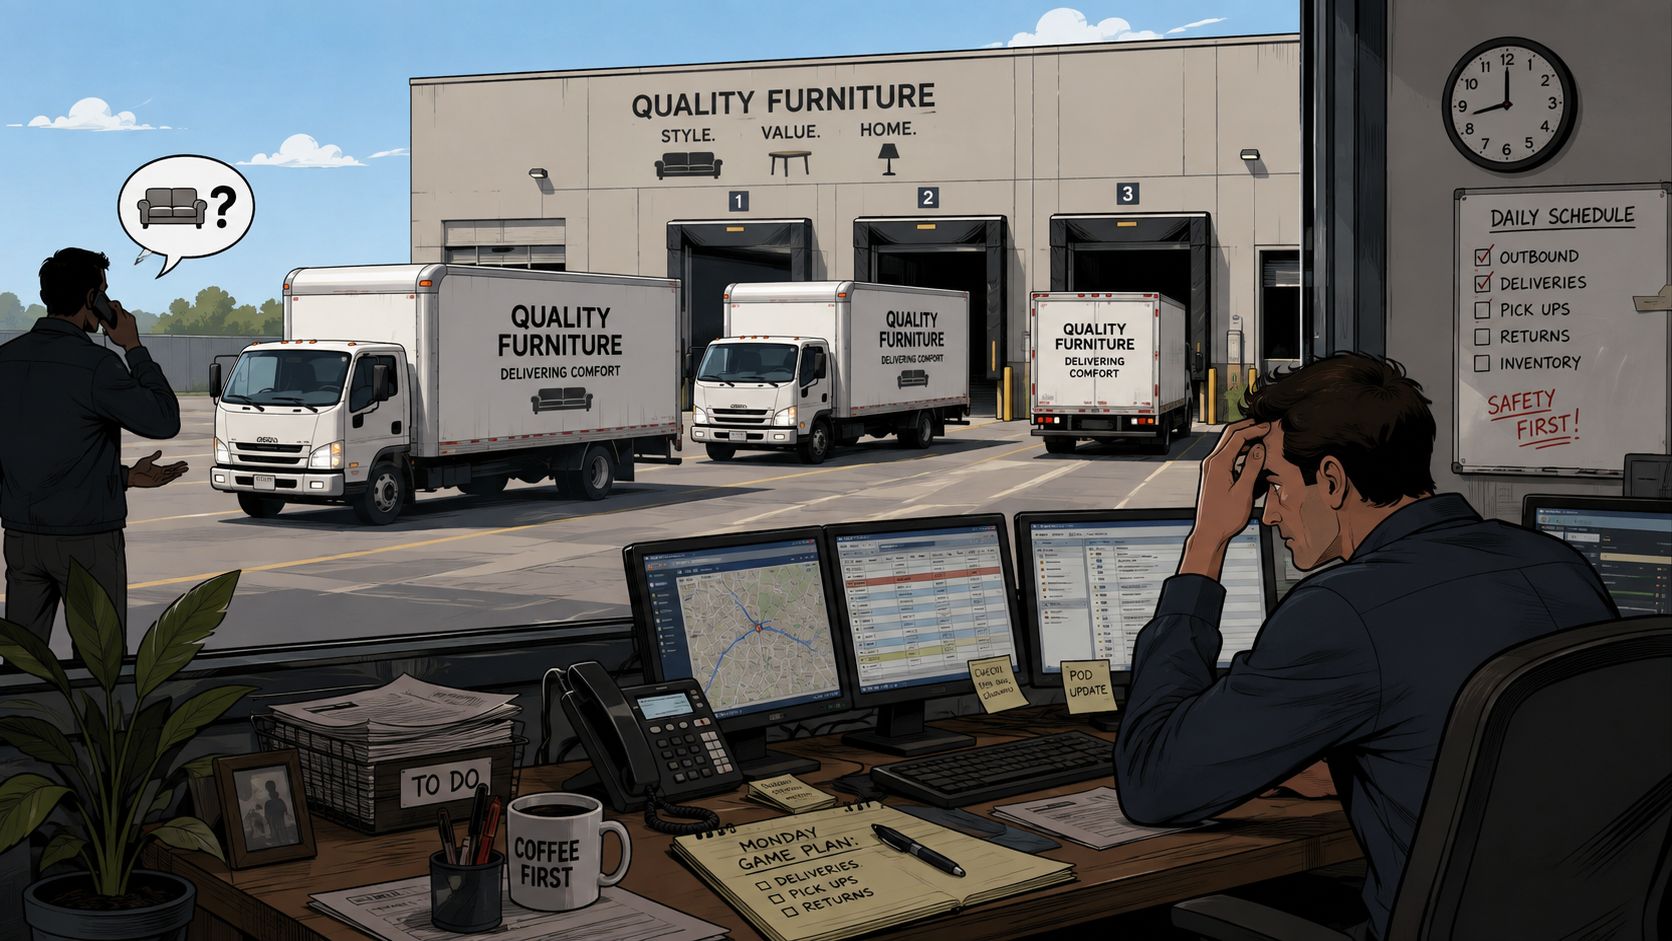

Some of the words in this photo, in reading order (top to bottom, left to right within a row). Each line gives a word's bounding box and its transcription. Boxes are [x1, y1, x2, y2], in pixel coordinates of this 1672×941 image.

[1481, 61, 1490, 73] 11
[1500, 53, 1515, 66] 12
[1465, 78, 1478, 90] 10
[1541, 74, 1550, 87] 2
[632, 90, 755, 120] QUALITY
[767, 82, 936, 113] FURNITURE
[1458, 100, 1467, 113] 9
[1548, 96, 1557, 109] 3
[761, 124, 821, 139] VALUE.
[860, 121, 917, 137] HOME.
[1465, 123, 1474, 135] 8
[1540, 120, 1550, 133] 4
[661, 128, 716, 143] STYLE.
[1525, 137, 1534, 149] 5
[1481, 138, 1490, 150] 7
[1502, 143, 1512, 156] 6
[922, 190, 934, 205] 2
[1123, 186, 1133, 201] 3
[210, 185, 237, 229] ?
[734, 194, 742, 209] 1
[1491, 208, 1540, 227] DAILY
[1548, 206, 1636, 224] SCHEDULE
[1500, 249, 1580, 264] OUTBOUND
[1500, 275, 1587, 291] DELIVERIES
[511, 304, 611, 330] QUALITY
[1500, 303, 1533, 318] PICK
[1541, 302, 1571, 316] UPS
[886, 310, 938, 328] QUALITY
[1063, 322, 1127, 336] QUALITY
[1500, 329, 1570, 344] RETURNS
[498, 333, 622, 357] FURNITURE
[880, 331, 944, 348] FURNITURE
[1055, 338, 1135, 351] FURNITURE
[1065, 356, 1125, 366] DELIVERING
[1500, 355, 1581, 371] INVENTORY
[500, 367, 567, 380] DELIVERING
[571, 365, 621, 378] COMFORT
[1069, 369, 1119, 378] COMFORT
[1487, 388, 1556, 415] SAFETY
[1517, 407, 1580, 440] FIRST!
[1069, 669, 1093, 681] POD
[1069, 684, 1108, 698] UPDATE
[411, 773, 440, 798] TO
[450, 768, 480, 793] DO
[739, 826, 818, 852] MONDAY
[514, 836, 580, 863] COFFEE
[738, 849, 796, 870] GAME
[800, 836, 859, 857] PLAN:
[521, 864, 574, 889] FIRST
[788, 884, 826, 899] PICK
[829, 875, 859, 889] UPS
[802, 887, 874, 913] RETURNS
